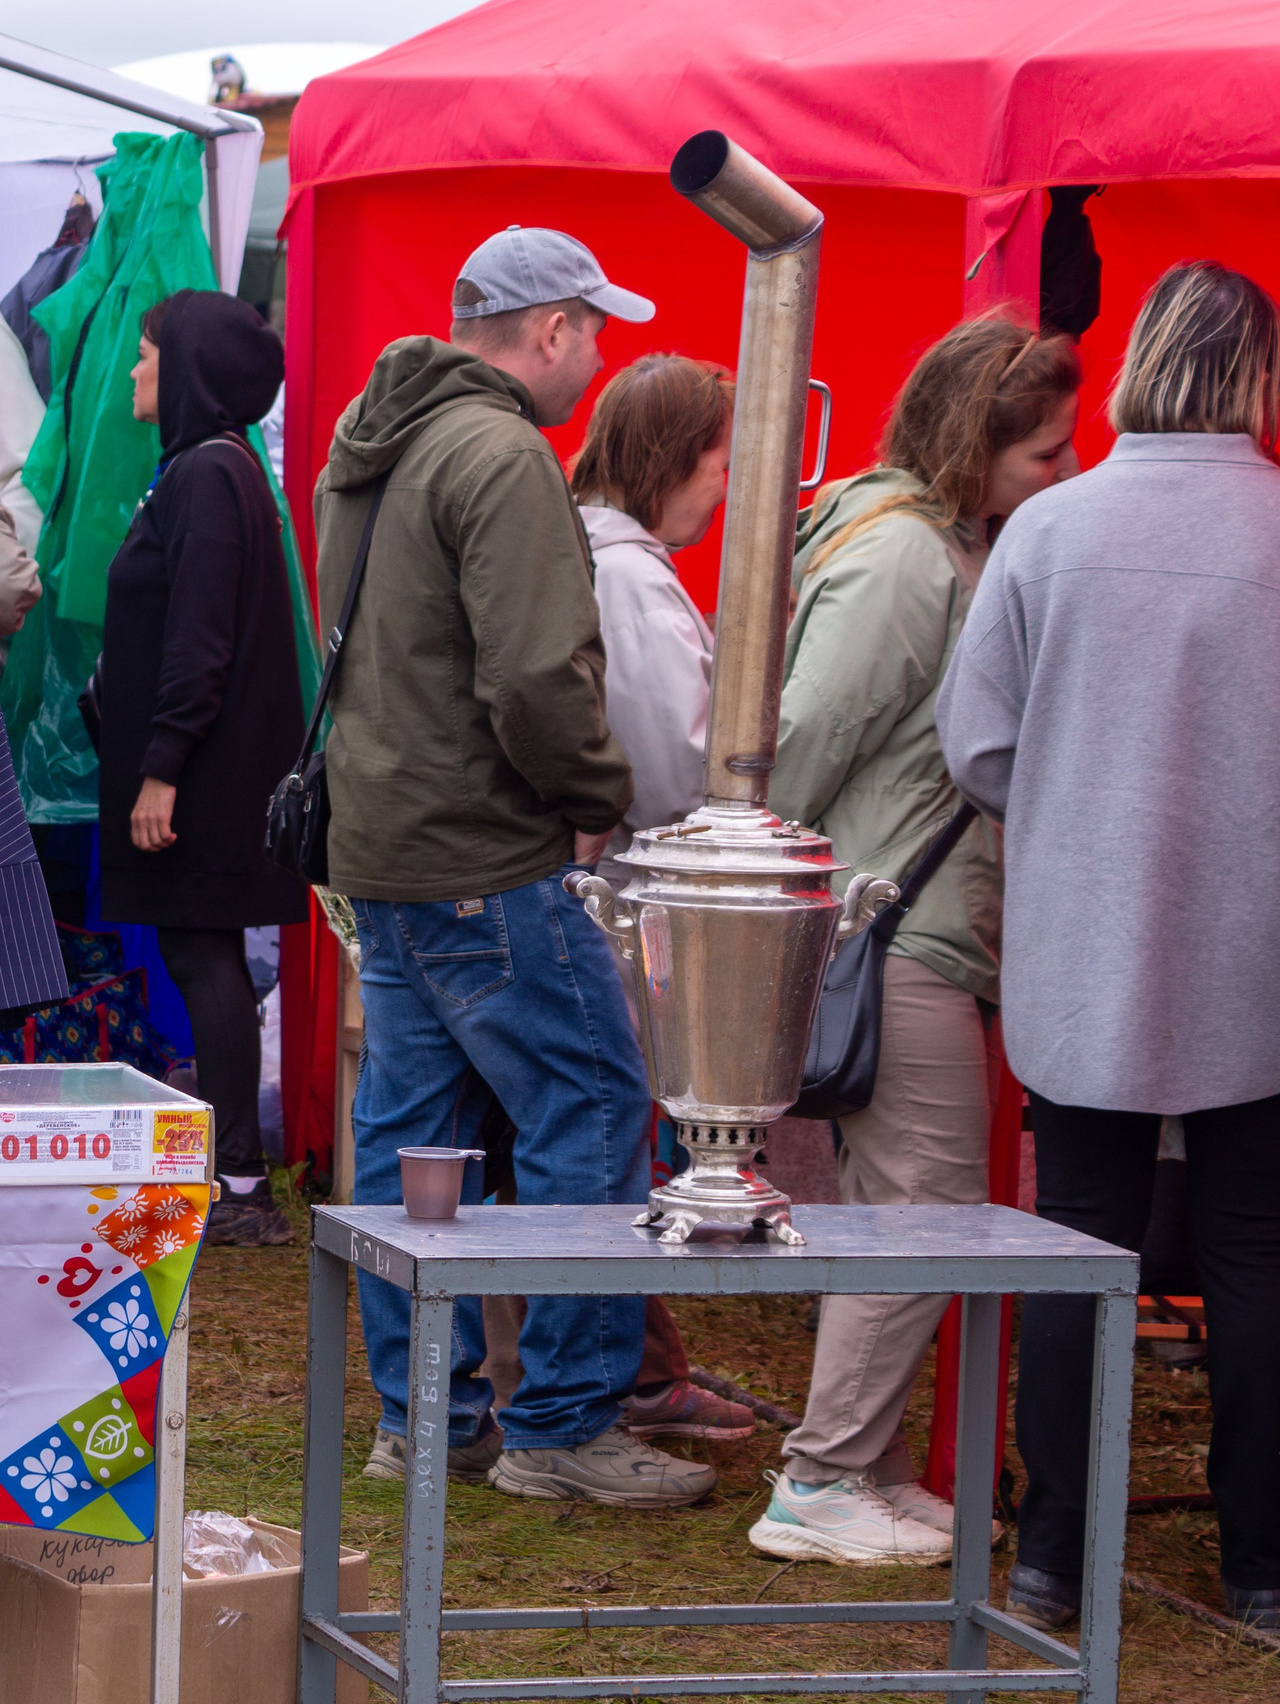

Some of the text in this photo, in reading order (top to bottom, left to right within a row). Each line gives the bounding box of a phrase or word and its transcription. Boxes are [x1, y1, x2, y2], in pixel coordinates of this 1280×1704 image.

[157, 1111, 192, 1124] УМНЫЙ
[1, 1134, 38, 1161] 01
[50, 1133, 111, 1160] 010
